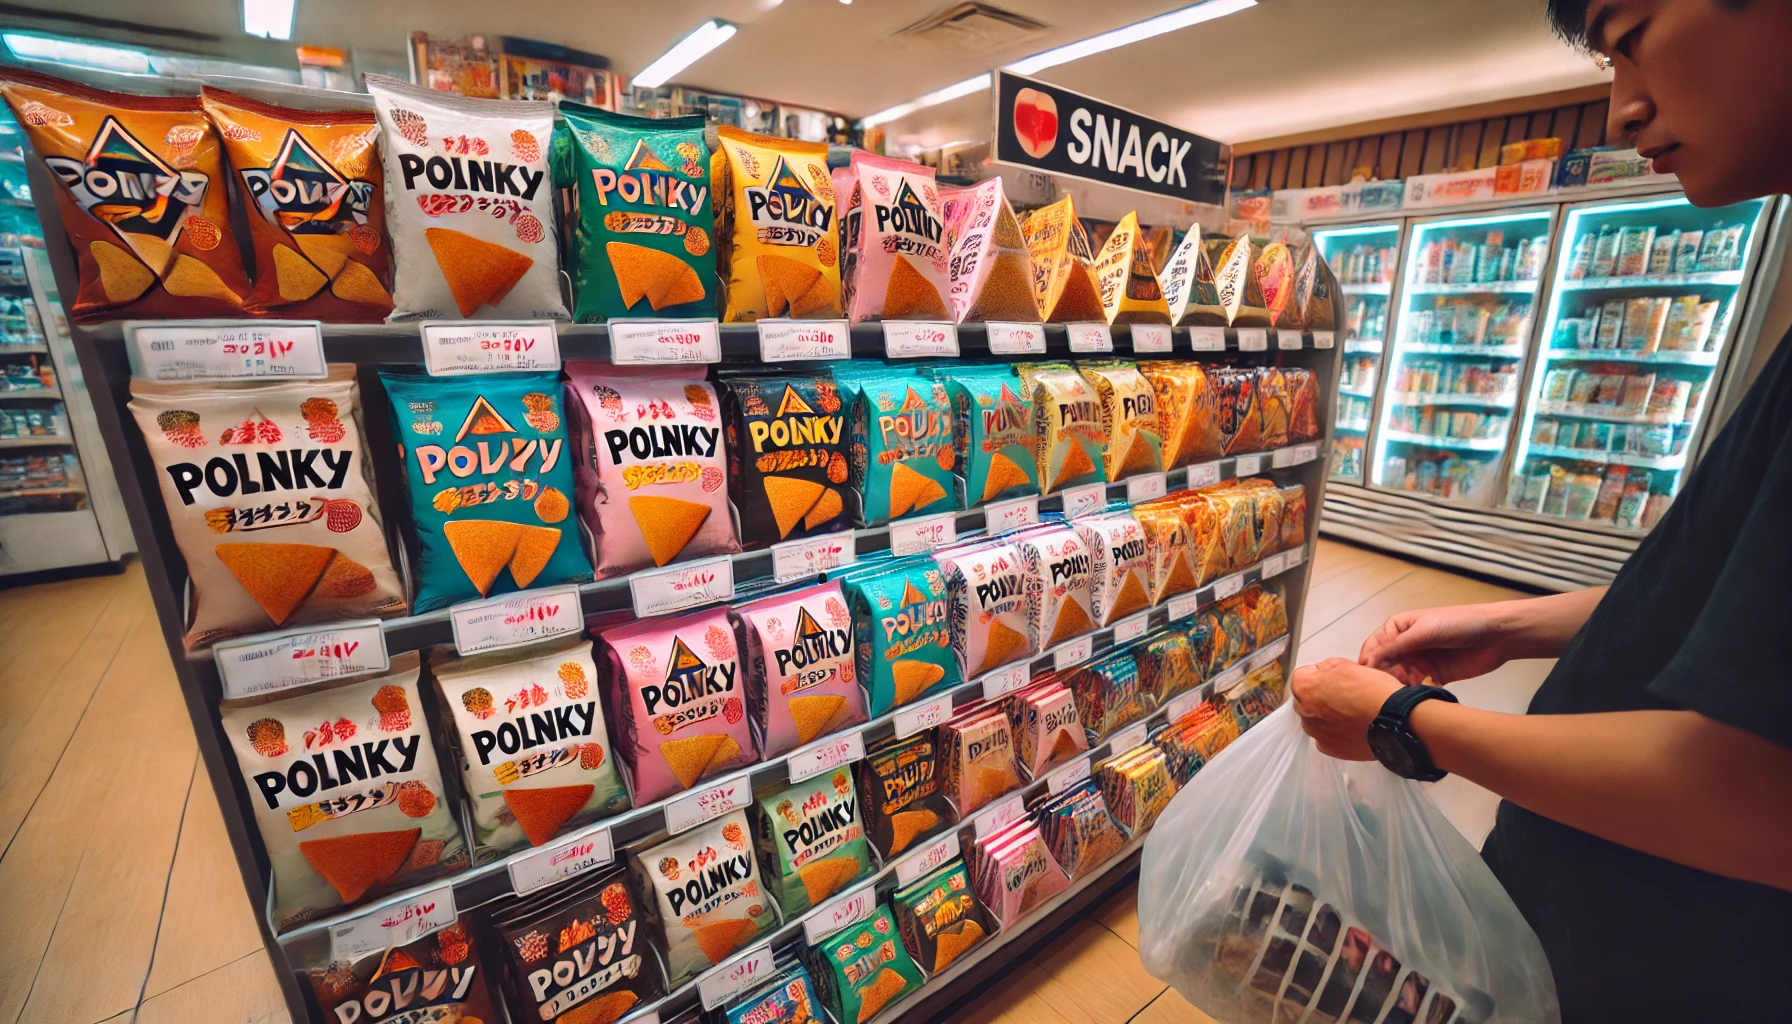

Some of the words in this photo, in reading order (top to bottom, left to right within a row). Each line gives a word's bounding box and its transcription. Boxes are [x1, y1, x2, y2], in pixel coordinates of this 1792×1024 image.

[1067, 108, 1192, 187] SNACK
[604, 424, 720, 465] POLNKY
[166, 449, 353, 506] POLNKY
[470, 701, 596, 765] POLNKY
[253, 735, 421, 810] POLNKY
